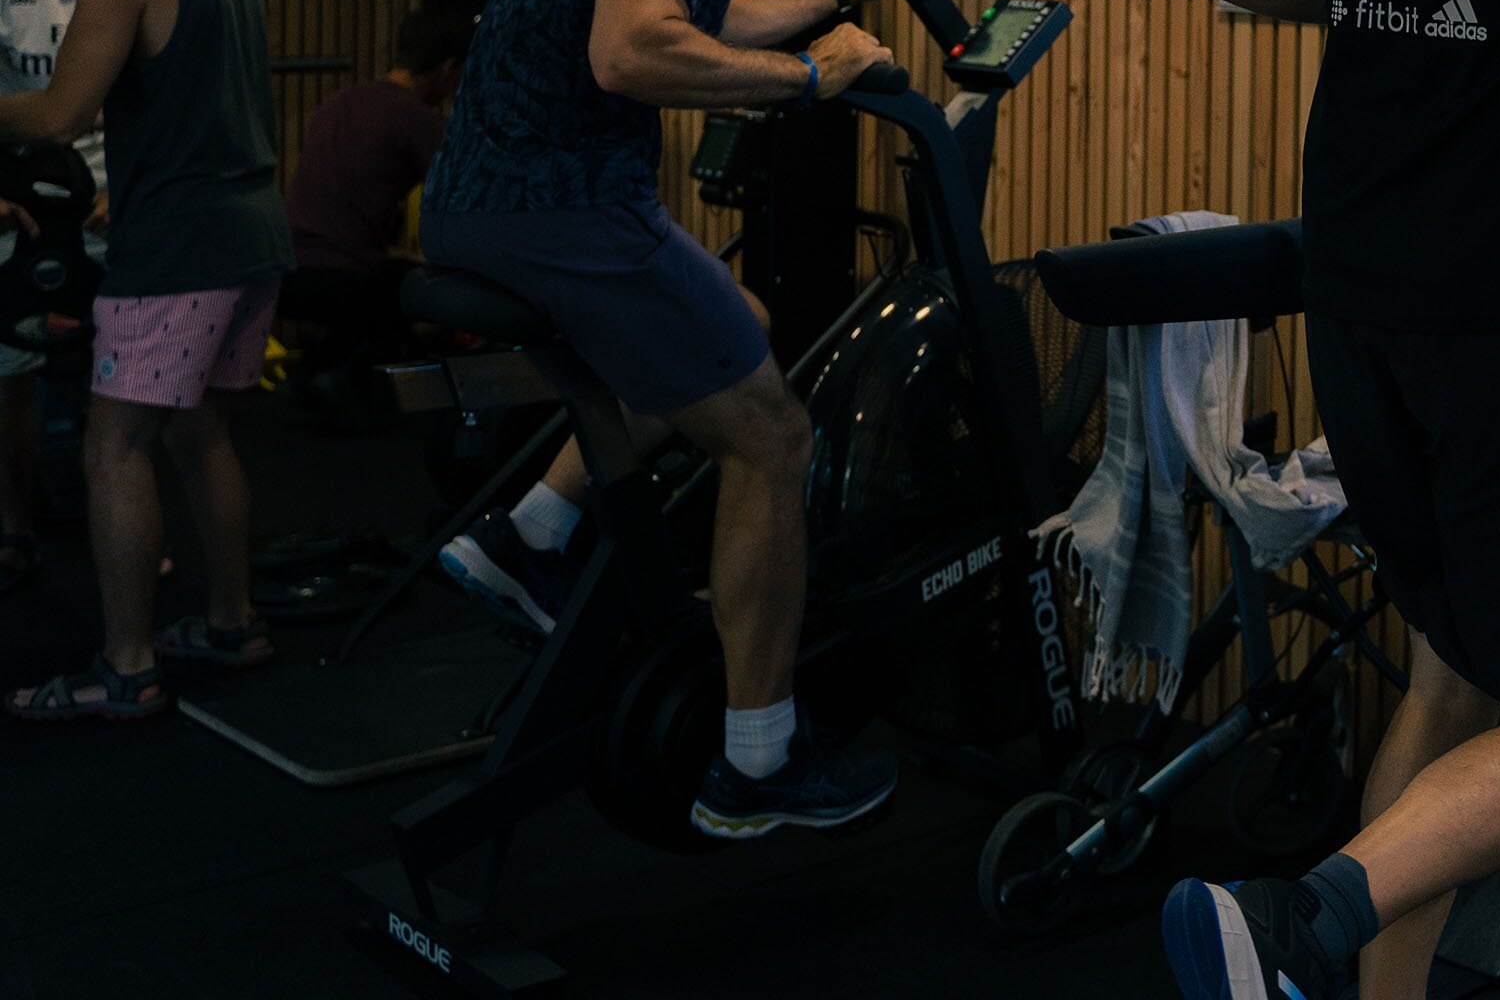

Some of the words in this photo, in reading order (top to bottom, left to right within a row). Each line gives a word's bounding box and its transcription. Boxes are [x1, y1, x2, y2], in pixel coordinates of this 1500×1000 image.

[1356, 0, 1418, 34] fitbit
[1424, 20, 1488, 41] adidas
[921, 560, 963, 602] ECHO
[967, 536, 1003, 576] BIKE
[1028, 568, 1075, 732] ROGUE
[389, 912, 452, 973] ROGUE
